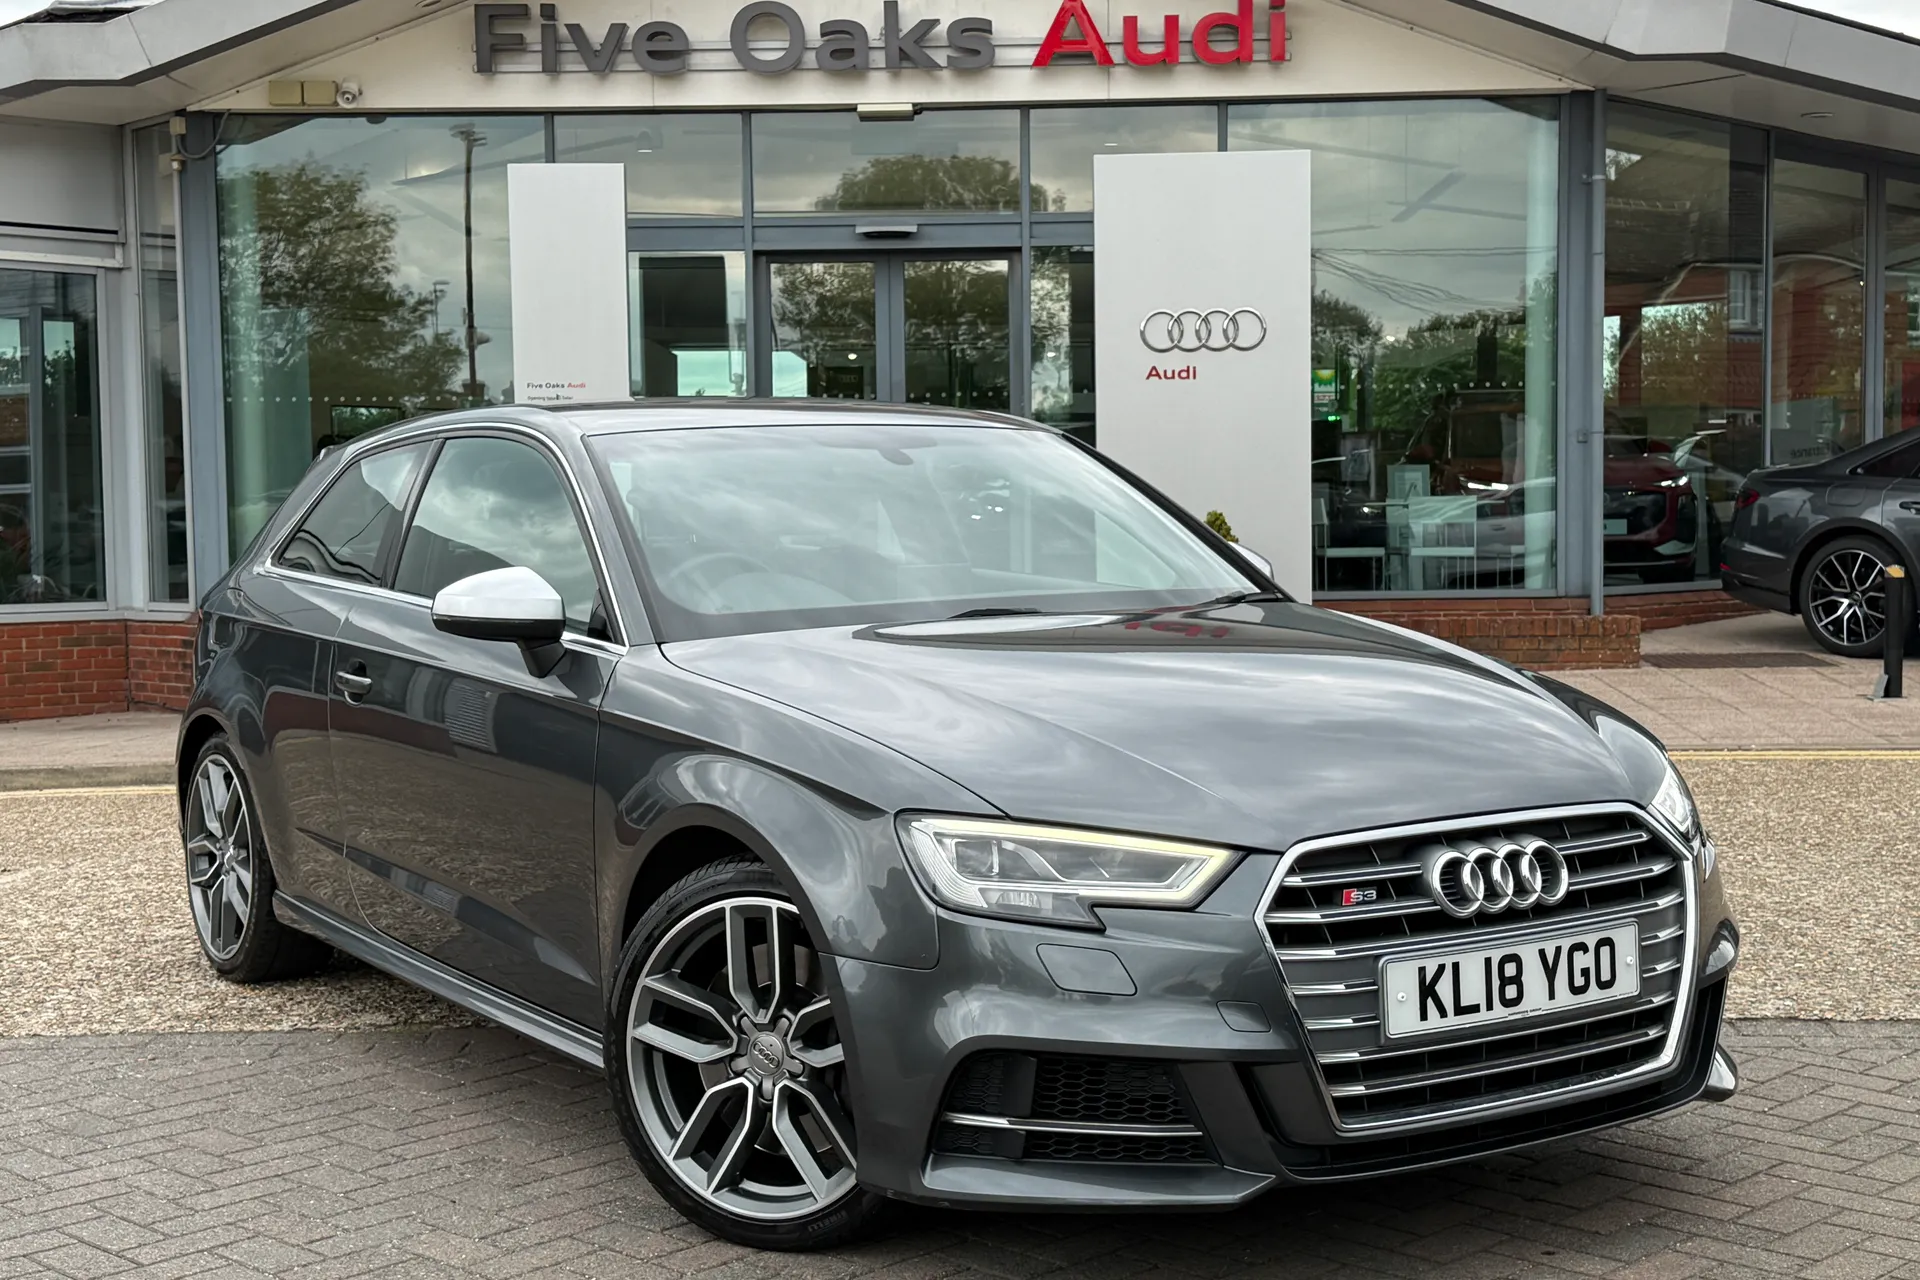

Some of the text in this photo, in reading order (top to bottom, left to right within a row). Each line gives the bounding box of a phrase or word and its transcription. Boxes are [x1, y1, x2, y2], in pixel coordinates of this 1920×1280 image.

[475, 0, 1287, 75] Five Oaks Audi
[1145, 365, 1197, 380] Audi
[1349, 889, 1377, 902] S3
[1417, 936, 1617, 1022] KL18 YGO
